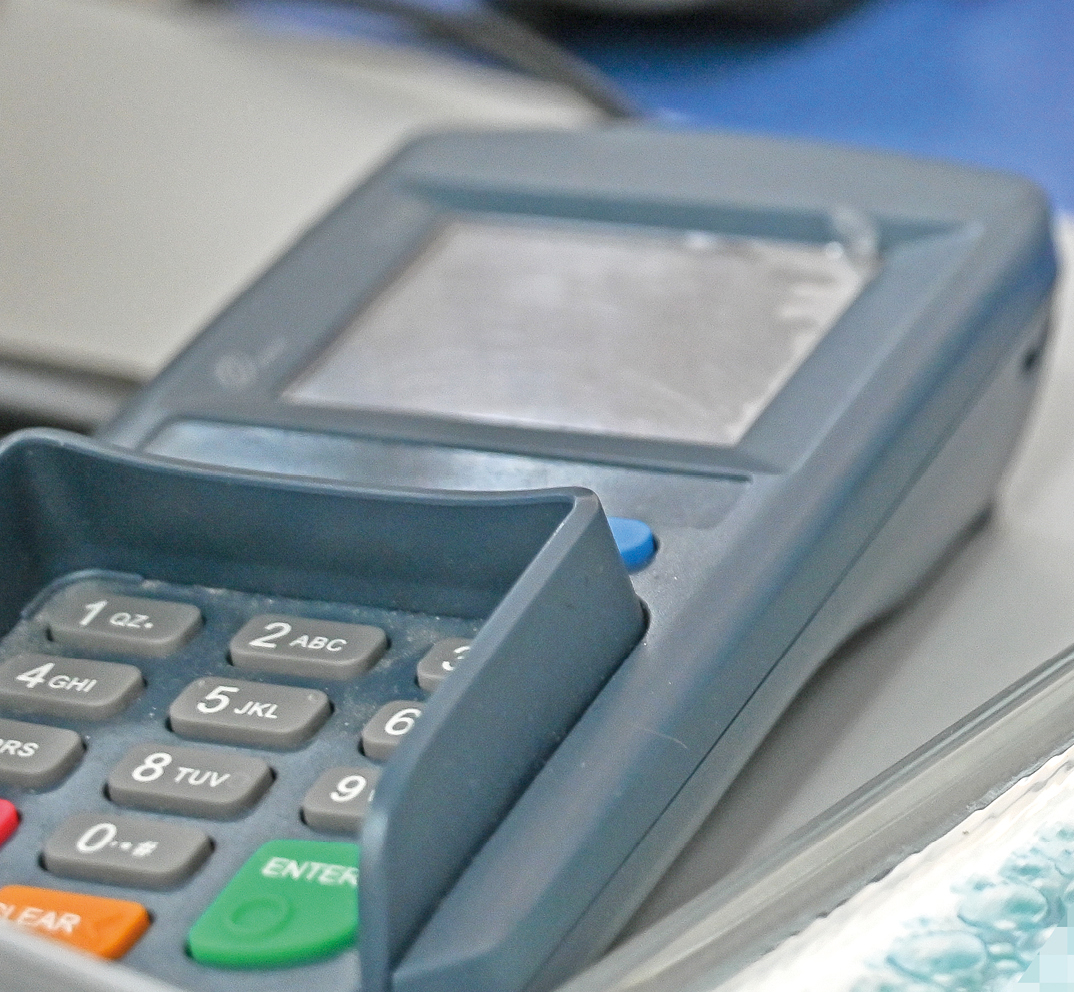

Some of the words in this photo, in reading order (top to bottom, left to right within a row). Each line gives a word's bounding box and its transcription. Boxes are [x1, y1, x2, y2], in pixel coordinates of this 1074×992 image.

[79, 600, 108, 626] 1
[248, 622, 292, 649] 2
[289, 635, 347, 652] ABC
[15, 662, 53, 689] 4
[48, 675, 97, 693] GHI
[196, 685, 240, 714] 5
[233, 701, 278, 719] JKL
[384, 708, 421, 736] 6
[0, 738, 40, 758] RS
[131, 752, 172, 782] 8
[174, 766, 231, 787] TUV
[330, 775, 367, 802] 9
[76, 822, 118, 854] 0
[262, 856, 359, 887] ENTER
[0, 901, 82, 934] EAR
